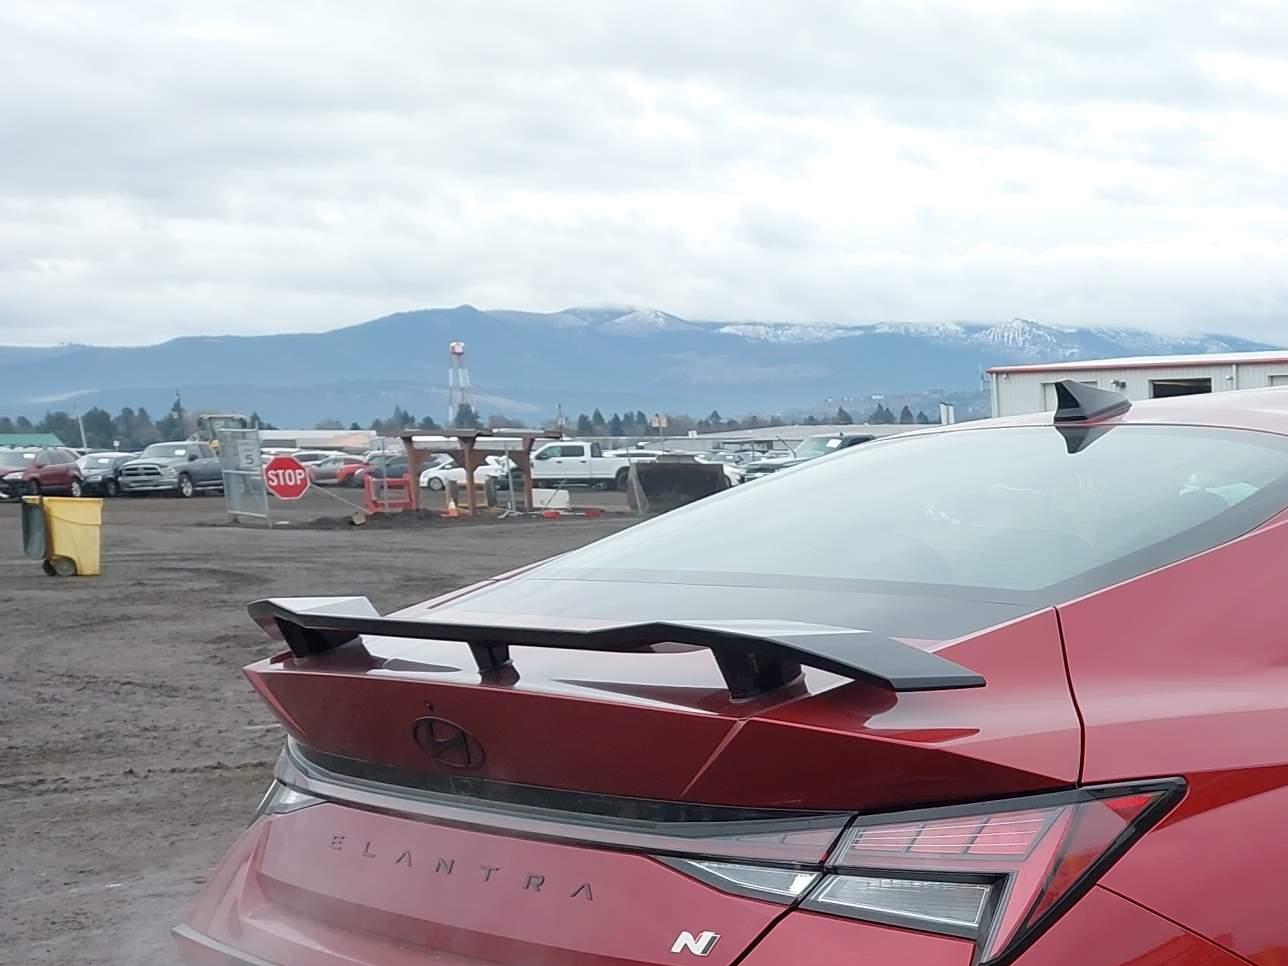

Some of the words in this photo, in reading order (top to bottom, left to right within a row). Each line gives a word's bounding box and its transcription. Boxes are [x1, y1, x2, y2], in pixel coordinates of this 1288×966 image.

[267, 469, 305, 486] STOP
[330, 835, 594, 901] ELANTRA
[670, 930, 721, 957] N
